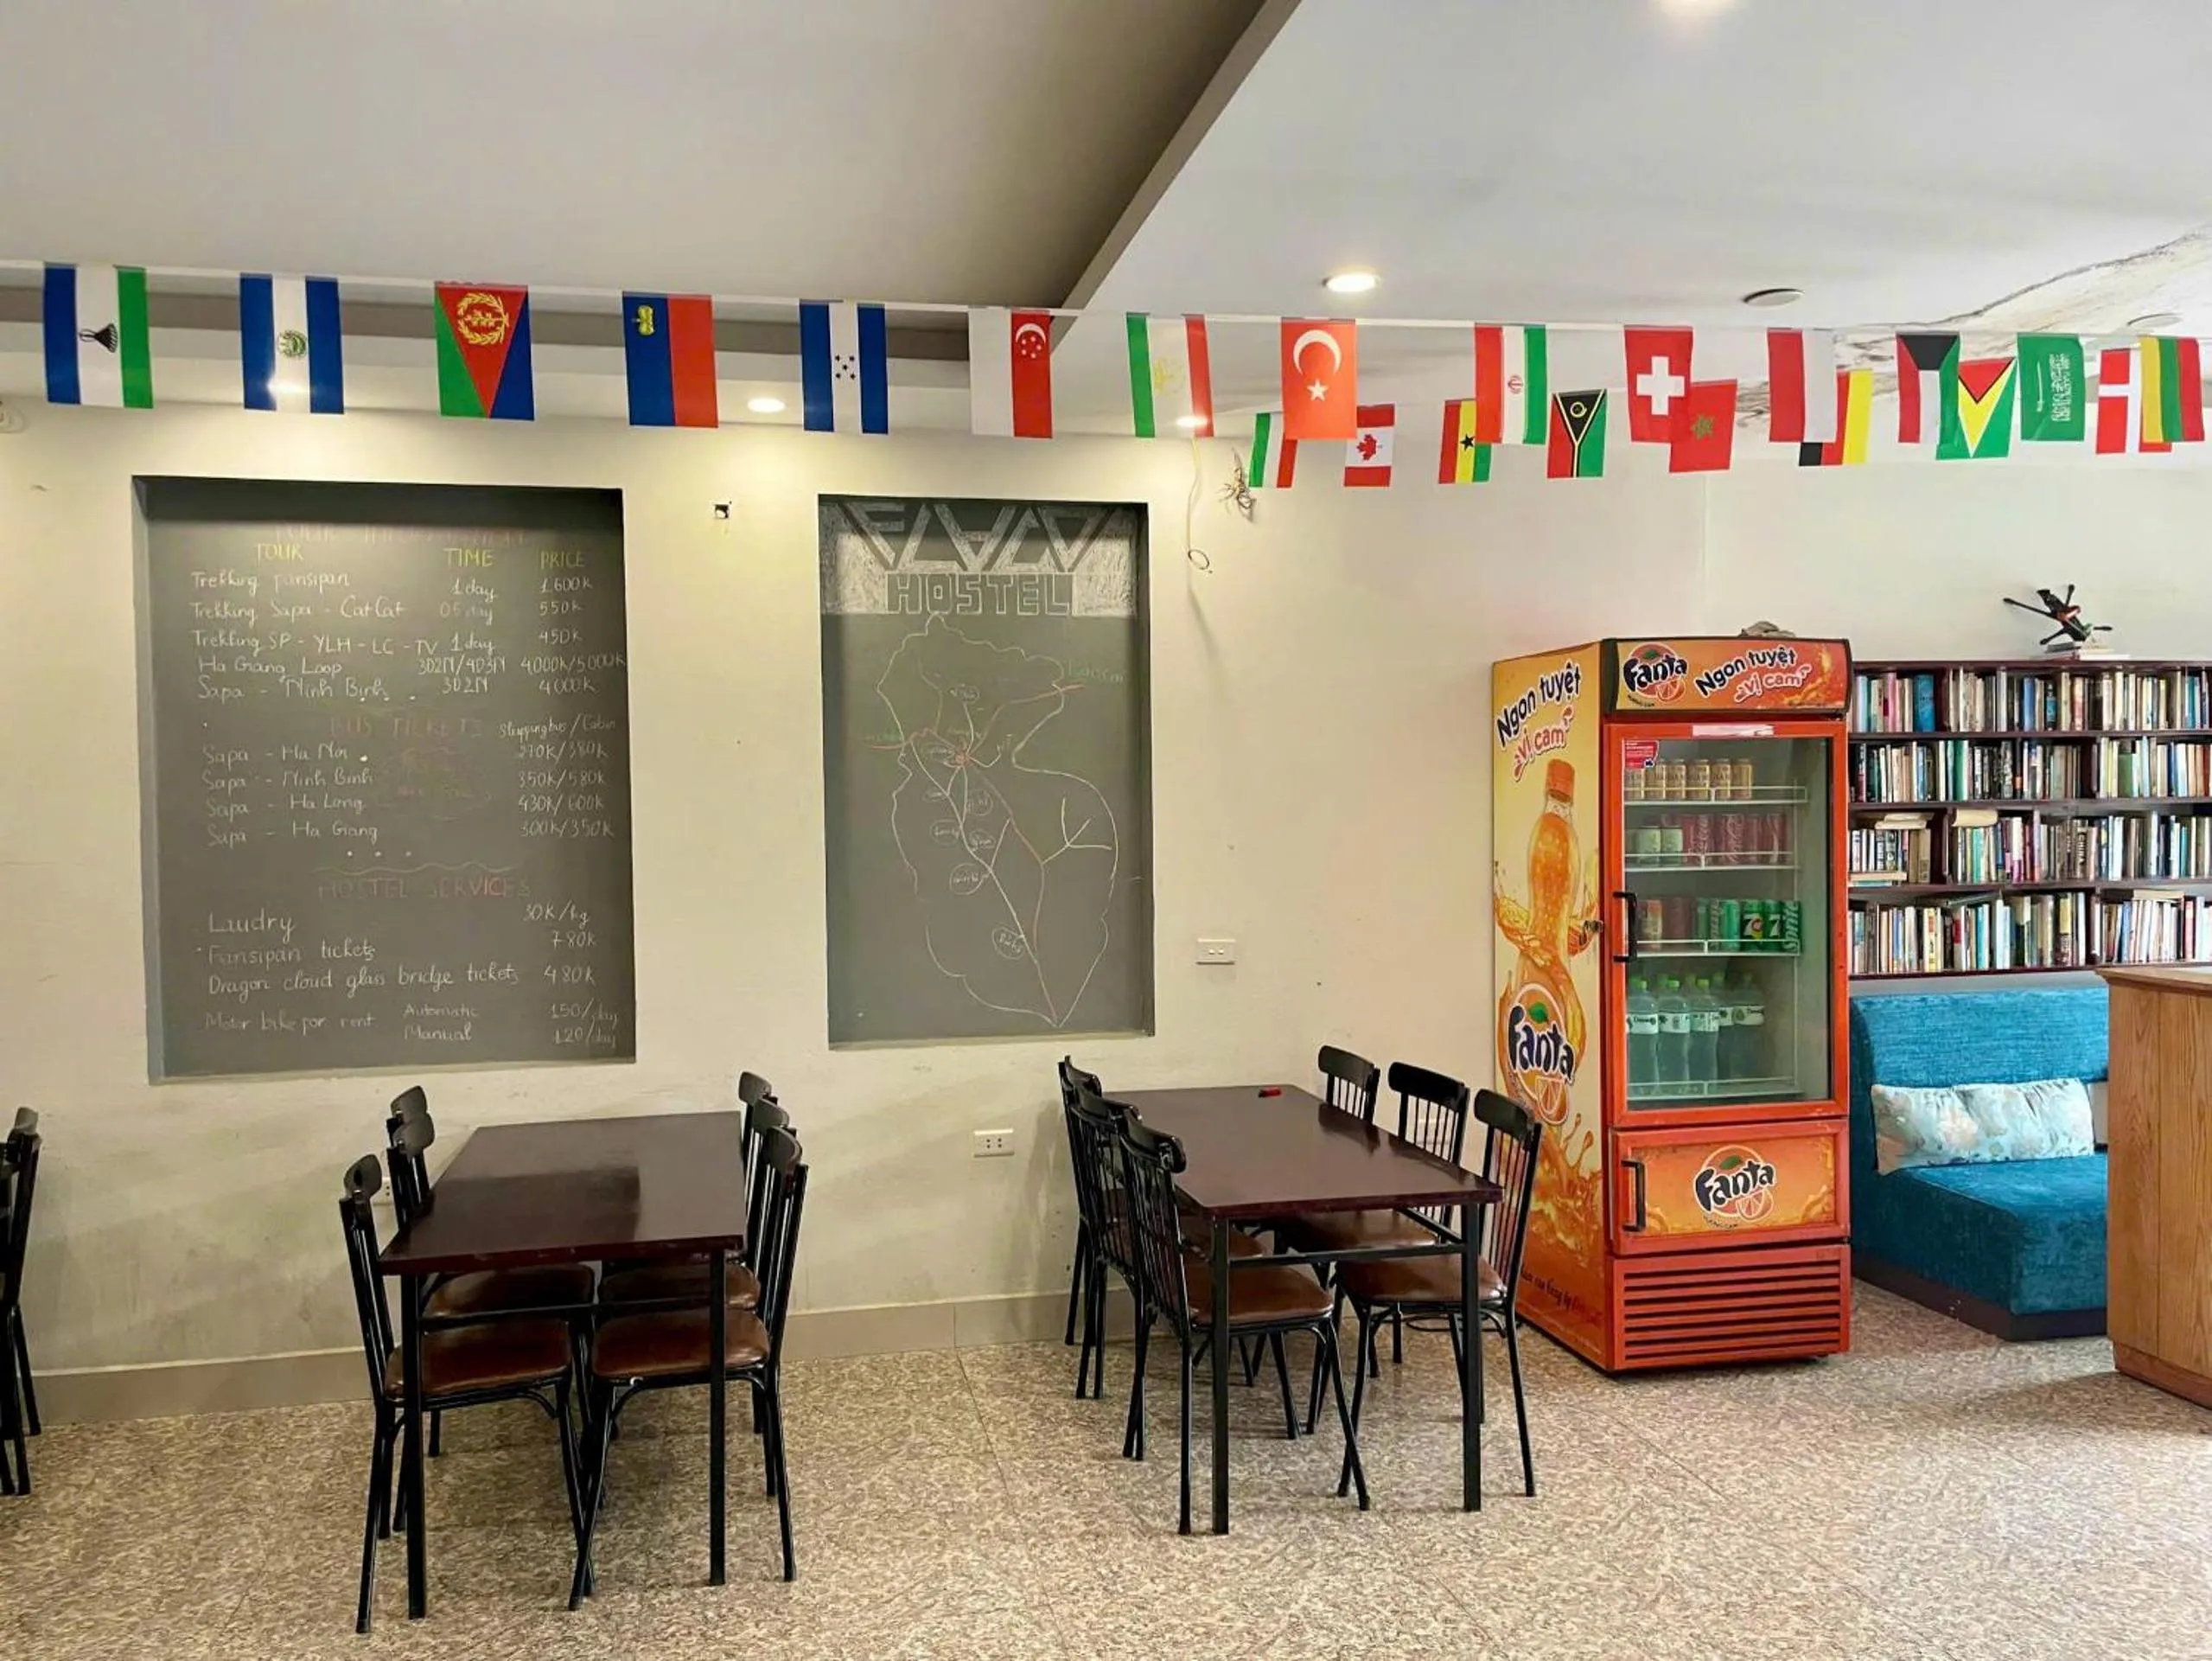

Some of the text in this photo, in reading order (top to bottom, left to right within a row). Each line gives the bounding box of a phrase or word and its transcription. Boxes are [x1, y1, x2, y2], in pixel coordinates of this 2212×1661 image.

[443, 548, 495, 568] TIME
[539, 551, 586, 571] PRICE
[189, 602, 258, 629] Trekking
[886, 573, 1073, 616] HOSTEL
[197, 674, 245, 705] Sapa
[1622, 646, 1796, 697] Fanta Ngon tuyệt
[1765, 674, 1801, 687] cam
[1495, 661, 1582, 749] Ngon tuyệt
[1533, 727, 1565, 751] cam
[208, 974, 271, 1004] Dragon
[283, 968, 334, 992] cloud
[398, 962, 455, 993] bridge
[465, 961, 520, 986] tickets
[1508, 1004, 1575, 1082] Fanta
[1694, 1160, 1775, 1212] Fanta
